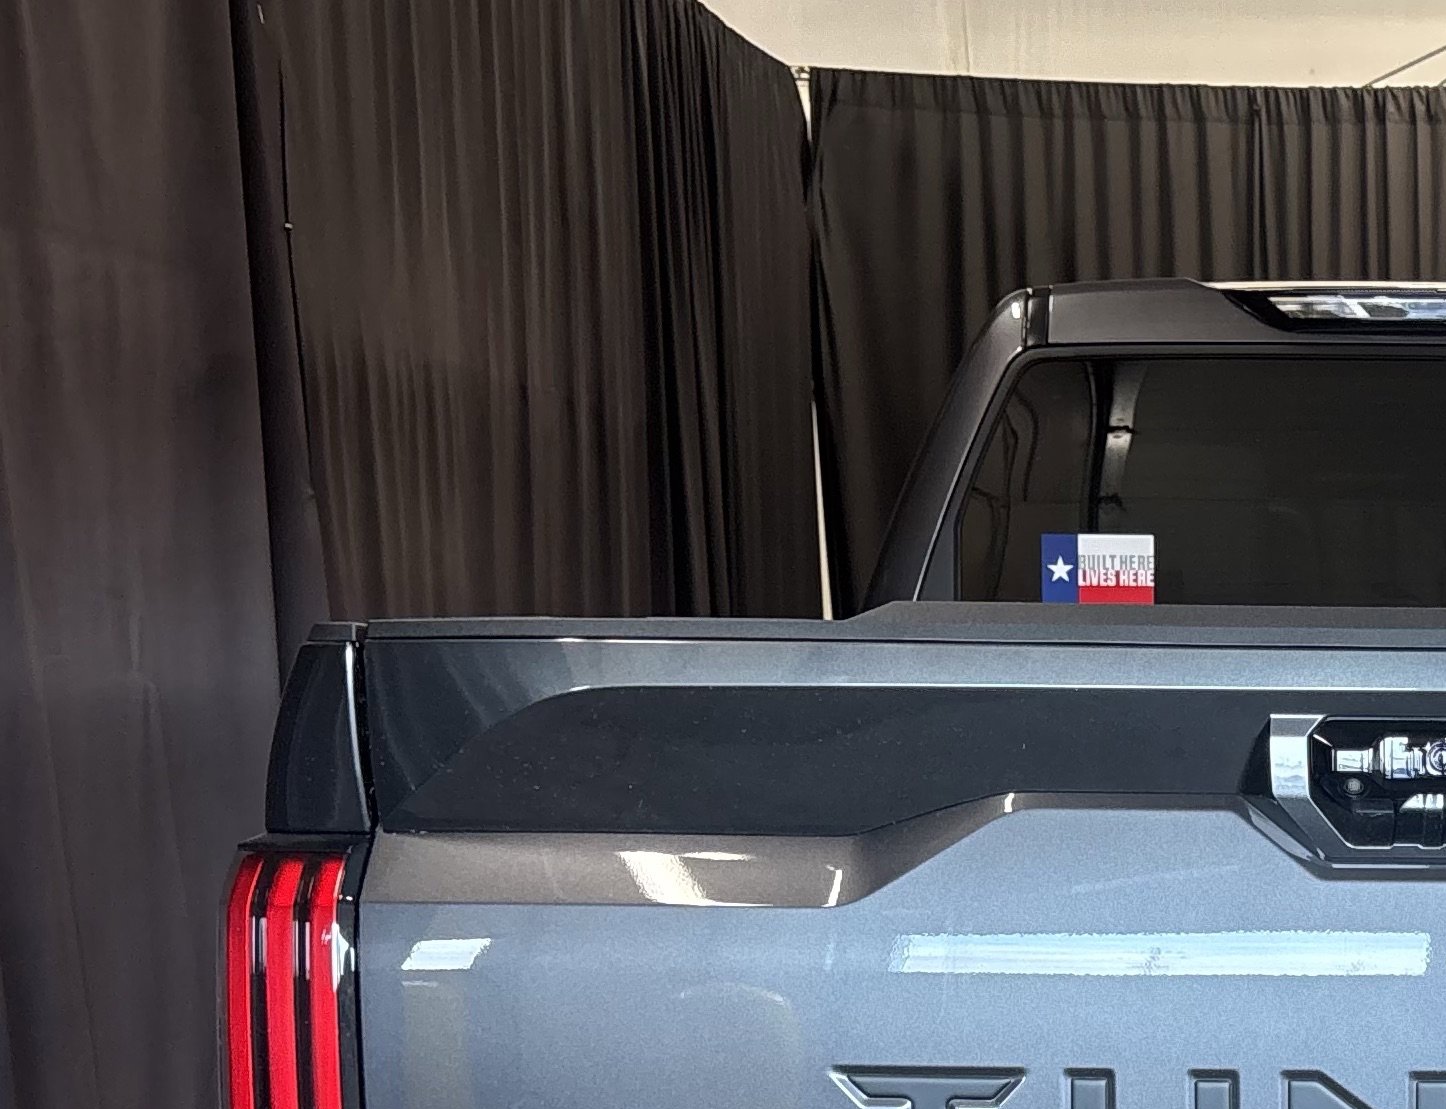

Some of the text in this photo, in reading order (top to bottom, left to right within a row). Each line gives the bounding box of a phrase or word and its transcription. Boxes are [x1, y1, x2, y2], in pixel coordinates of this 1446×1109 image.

[1078, 555, 1155, 570] BUILT HERE
[1078, 570, 1155, 587] LIVES HERE
